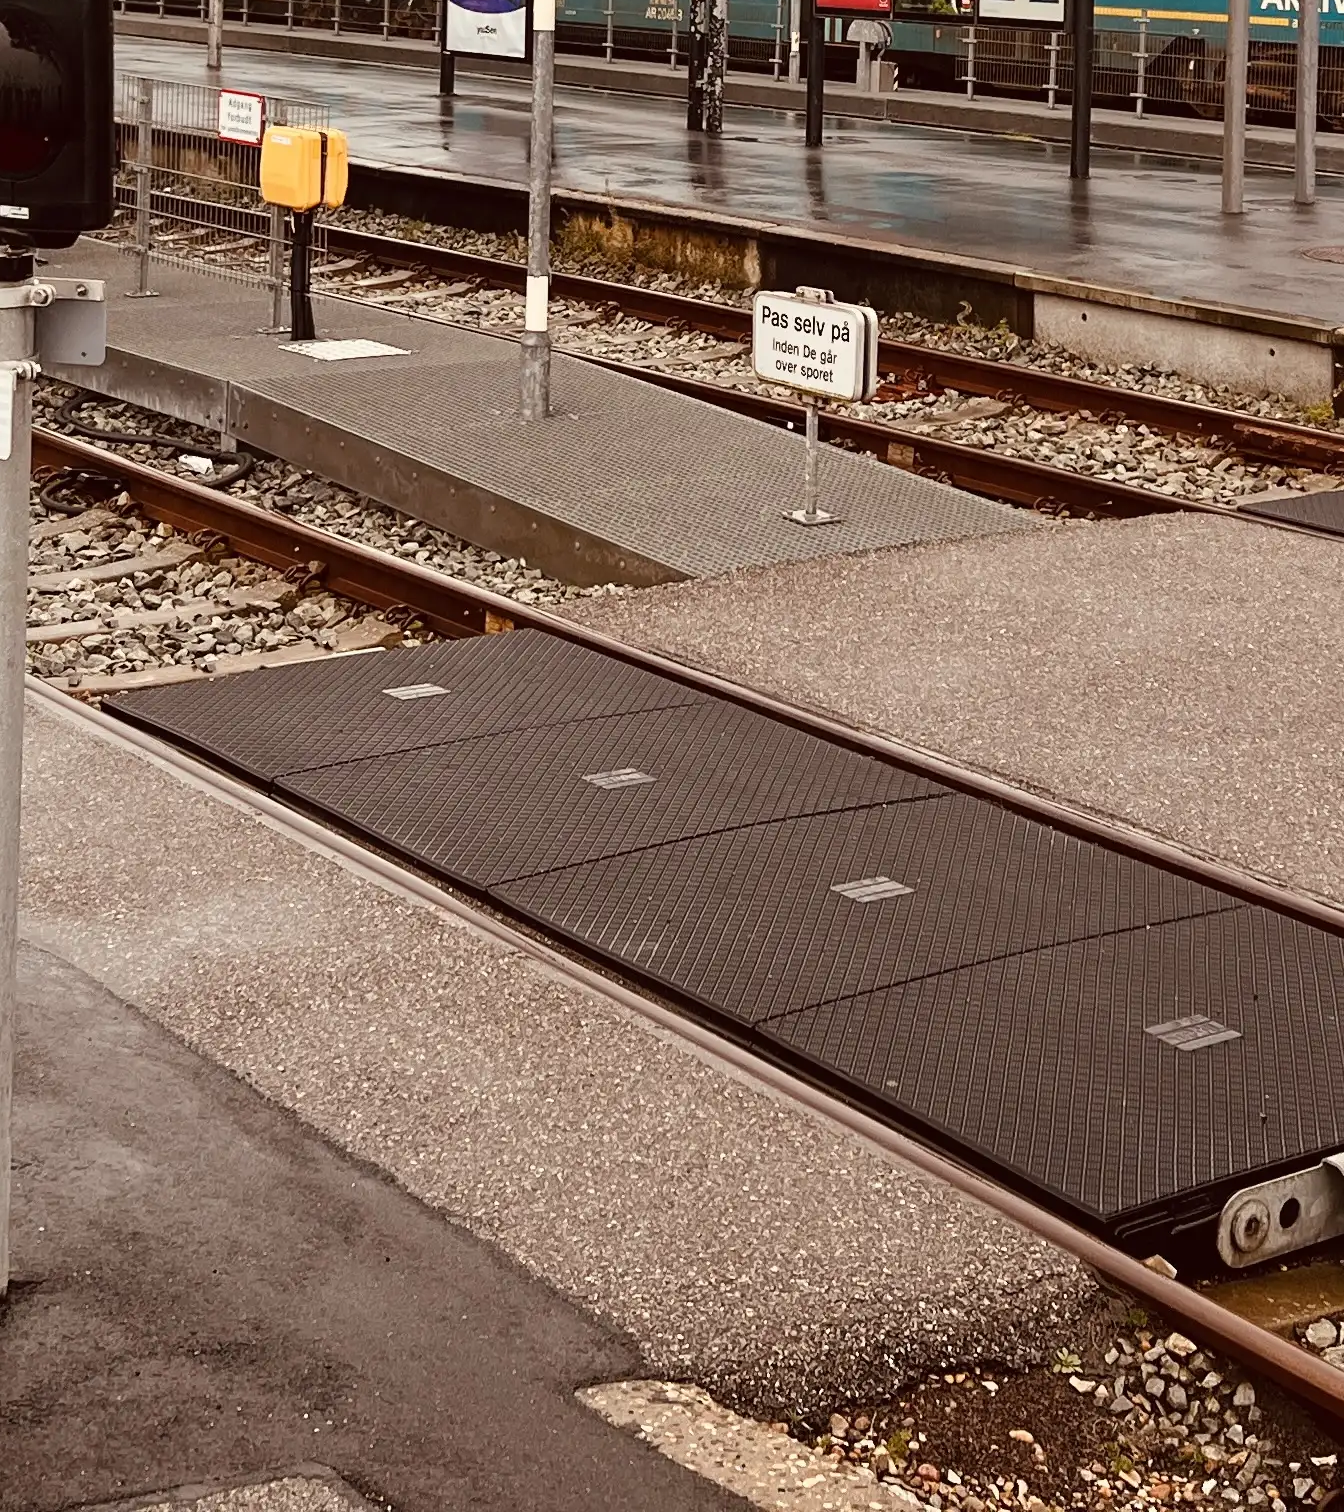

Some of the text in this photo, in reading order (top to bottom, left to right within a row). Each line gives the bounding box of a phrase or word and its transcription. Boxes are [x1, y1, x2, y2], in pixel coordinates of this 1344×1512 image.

[761, 305, 850, 344] Pas selv på
[803, 344, 817, 361] De
[820, 348, 838, 365] går
[775, 359, 834, 383] over sporet
